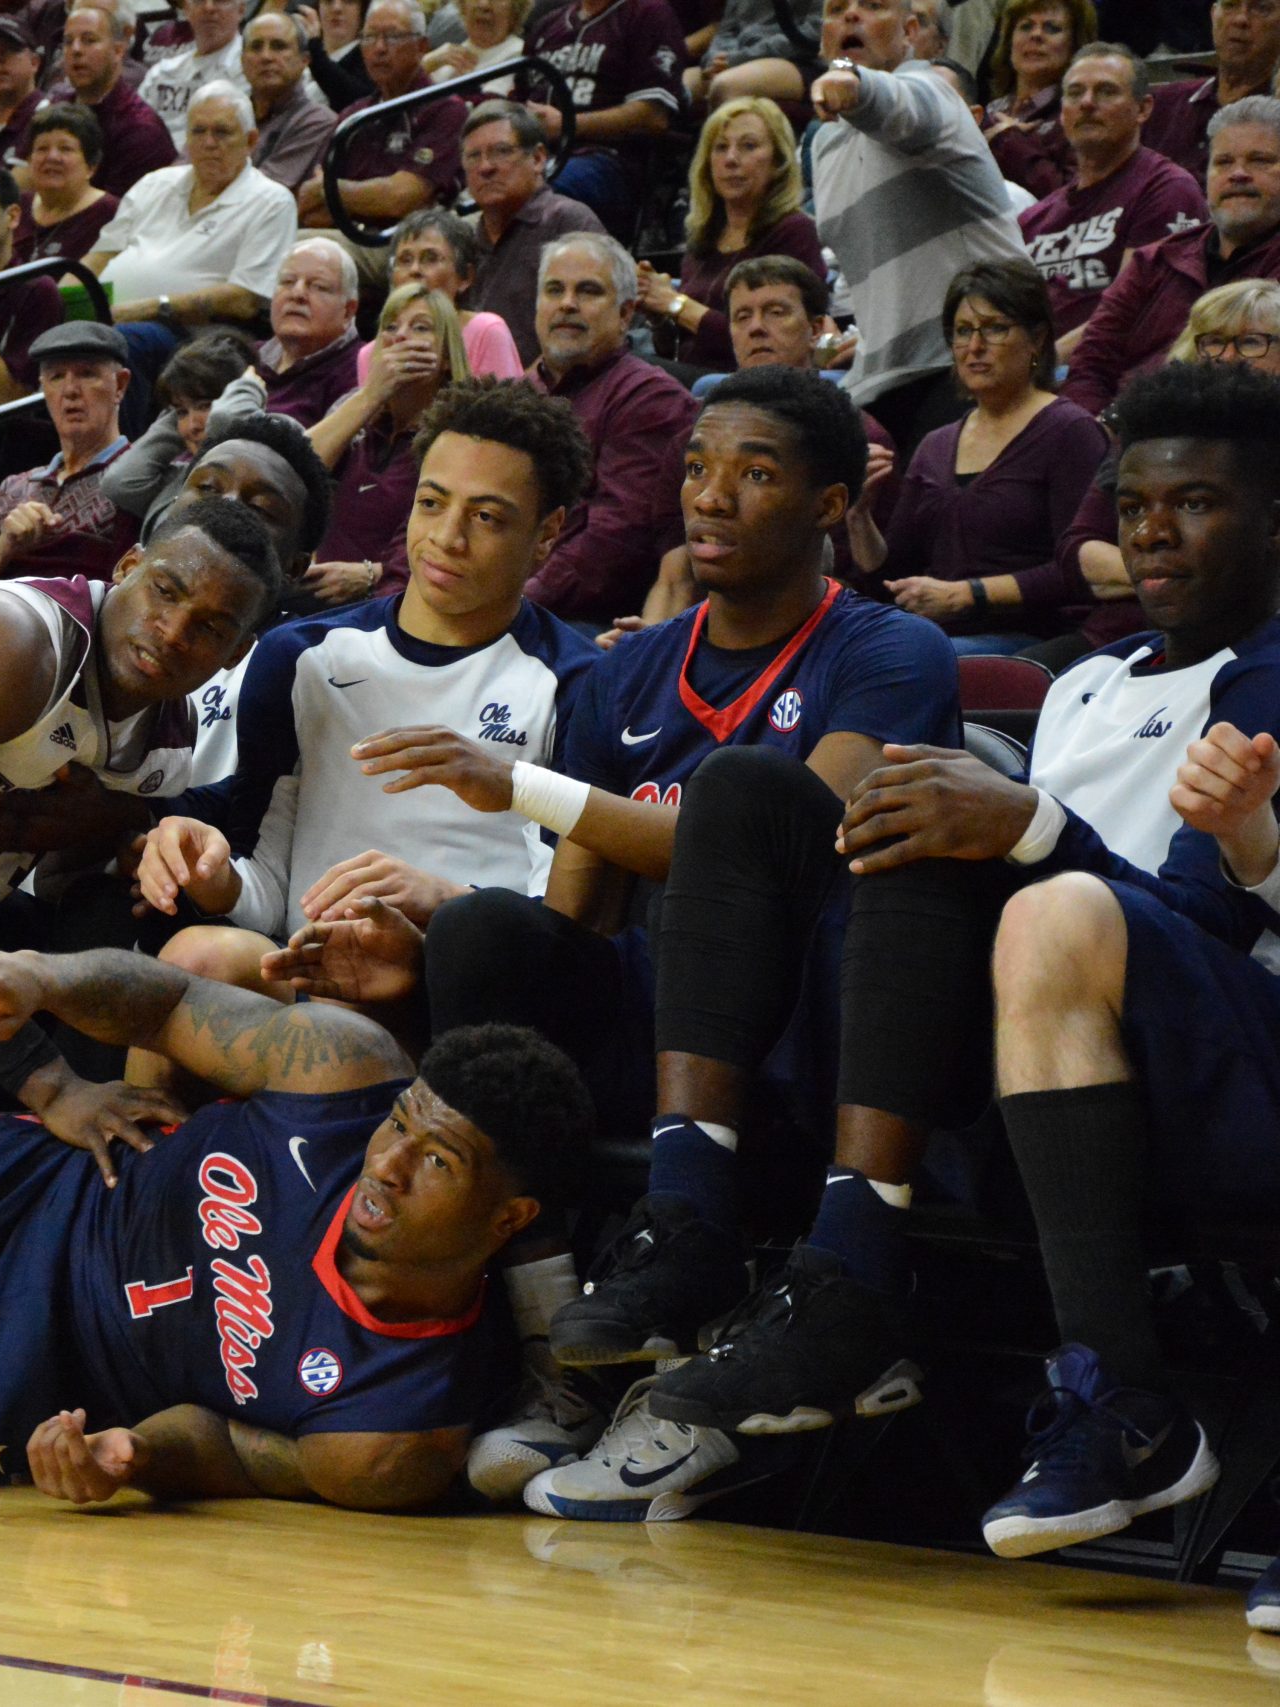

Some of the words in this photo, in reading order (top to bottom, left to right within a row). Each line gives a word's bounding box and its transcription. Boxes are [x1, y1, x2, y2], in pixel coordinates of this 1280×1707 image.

[479, 702, 512, 723] Ole
[771, 690, 802, 729] SEC
[478, 723, 528, 746] Miss
[198, 1152, 262, 1250] Ole
[124, 1265, 193, 1319] 1
[211, 1254, 274, 1402] Miss
[301, 1351, 340, 1392] SEC
